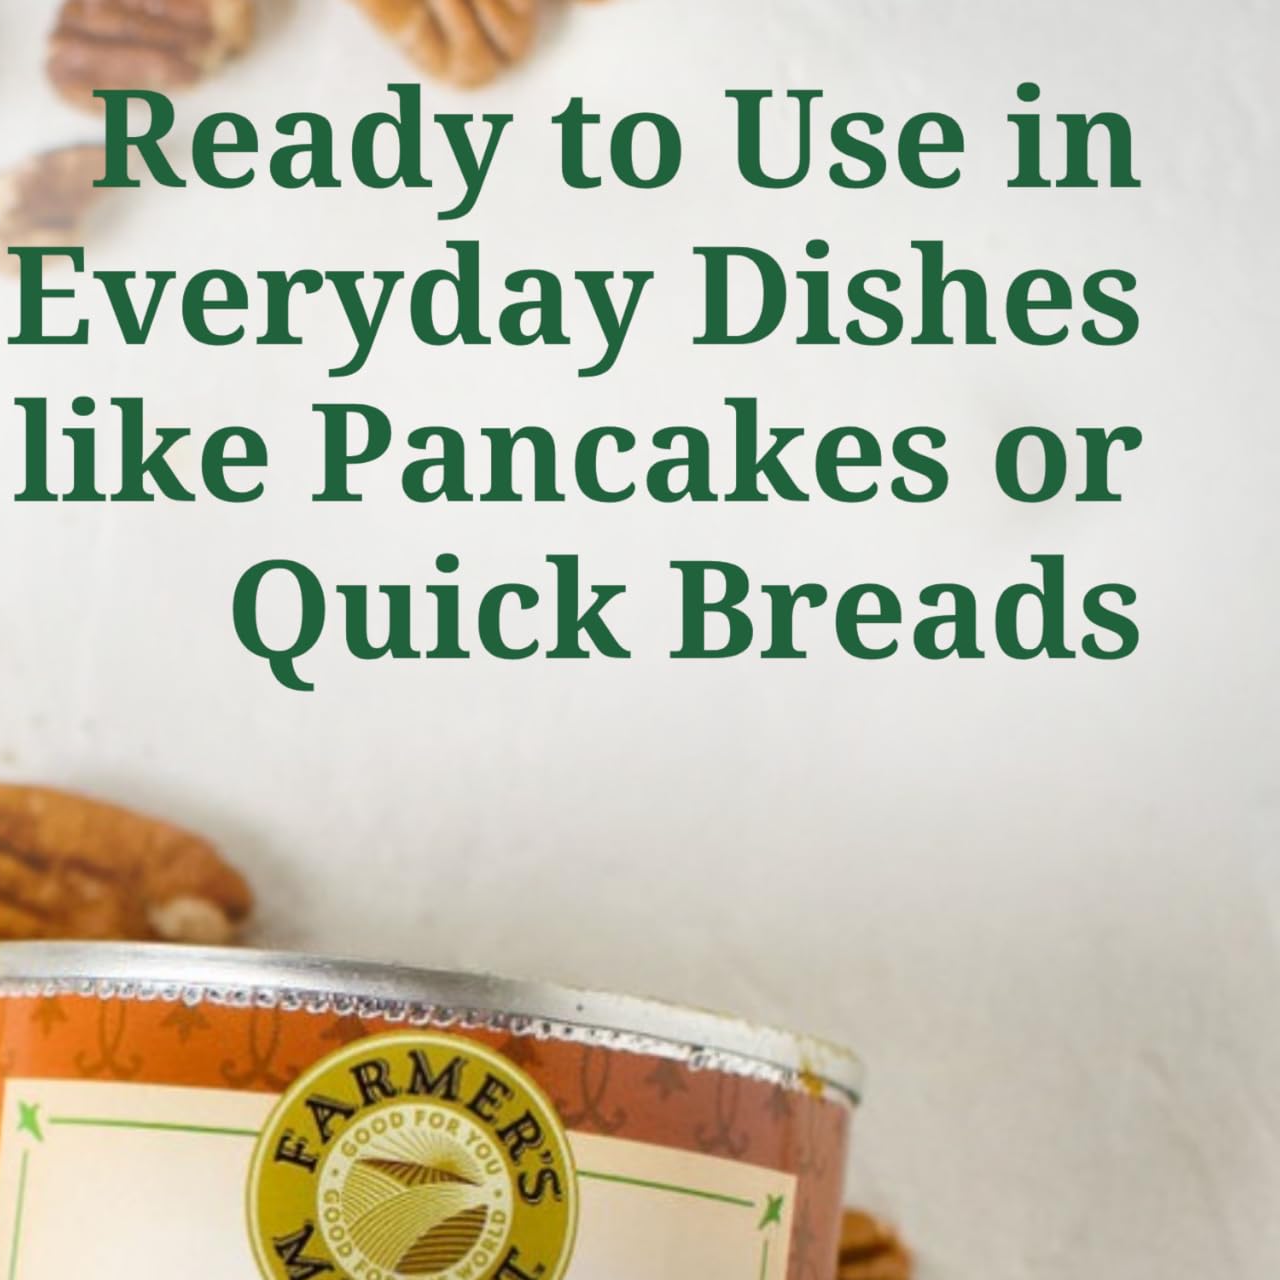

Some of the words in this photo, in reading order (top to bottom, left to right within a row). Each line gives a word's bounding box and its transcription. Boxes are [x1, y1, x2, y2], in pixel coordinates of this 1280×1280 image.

[275, 1050, 562, 1206] FARMER'S
[340, 1109, 404, 1158] GOOD
[414, 1109, 460, 1134] FOR
[464, 1127, 503, 1176] YOU
[322, 1188, 355, 1257] GOOD
[456, 1207, 508, 1280] WORLD
